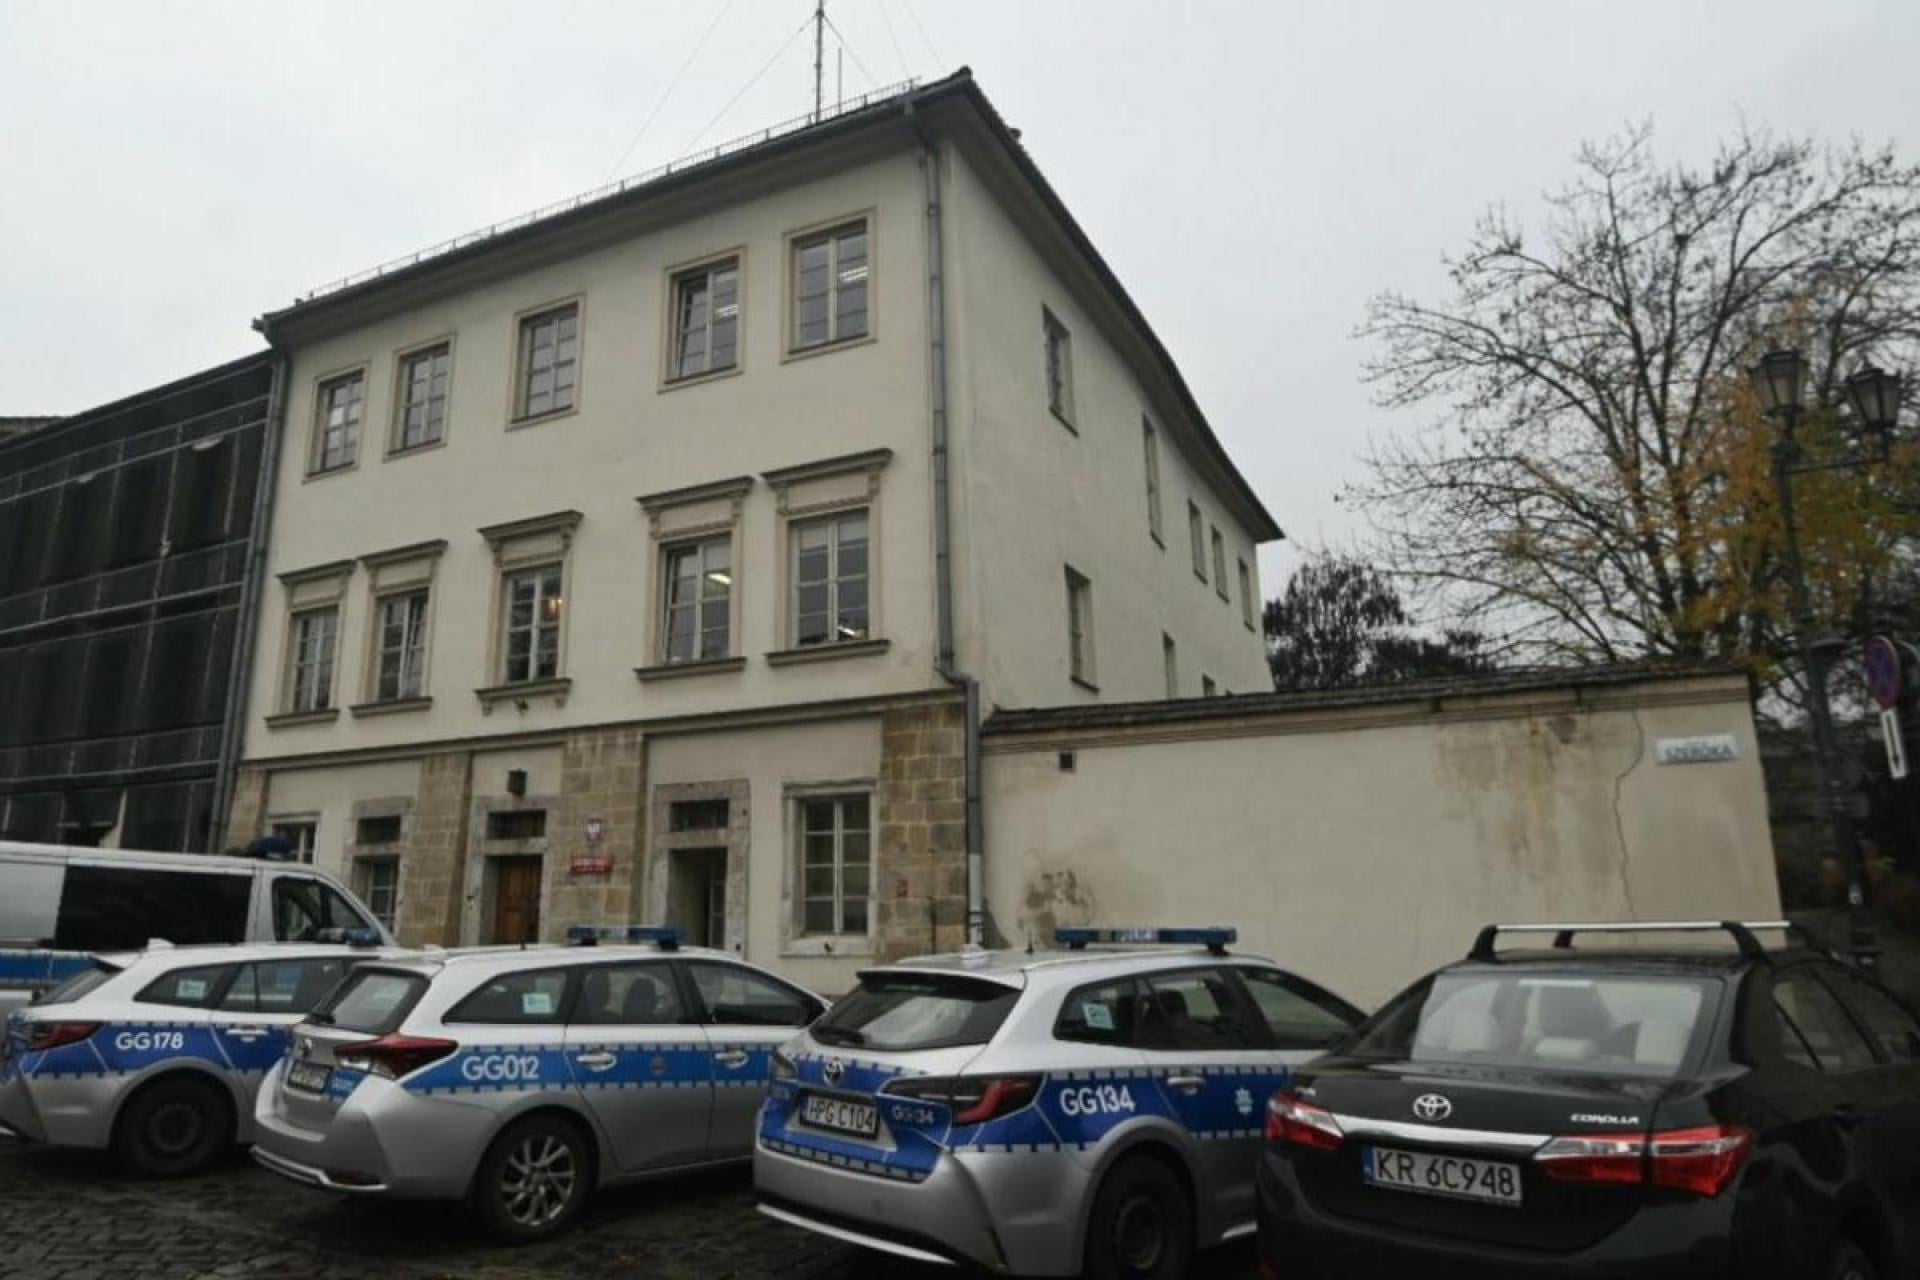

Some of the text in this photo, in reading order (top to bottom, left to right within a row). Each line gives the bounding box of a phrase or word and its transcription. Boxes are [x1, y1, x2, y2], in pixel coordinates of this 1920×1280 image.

[462, 1055, 540, 1081] GG012
[1060, 1085, 1136, 1116] GG134
[839, 1104, 875, 1132] C104
[1377, 1151, 1515, 1196] KR 6C948
